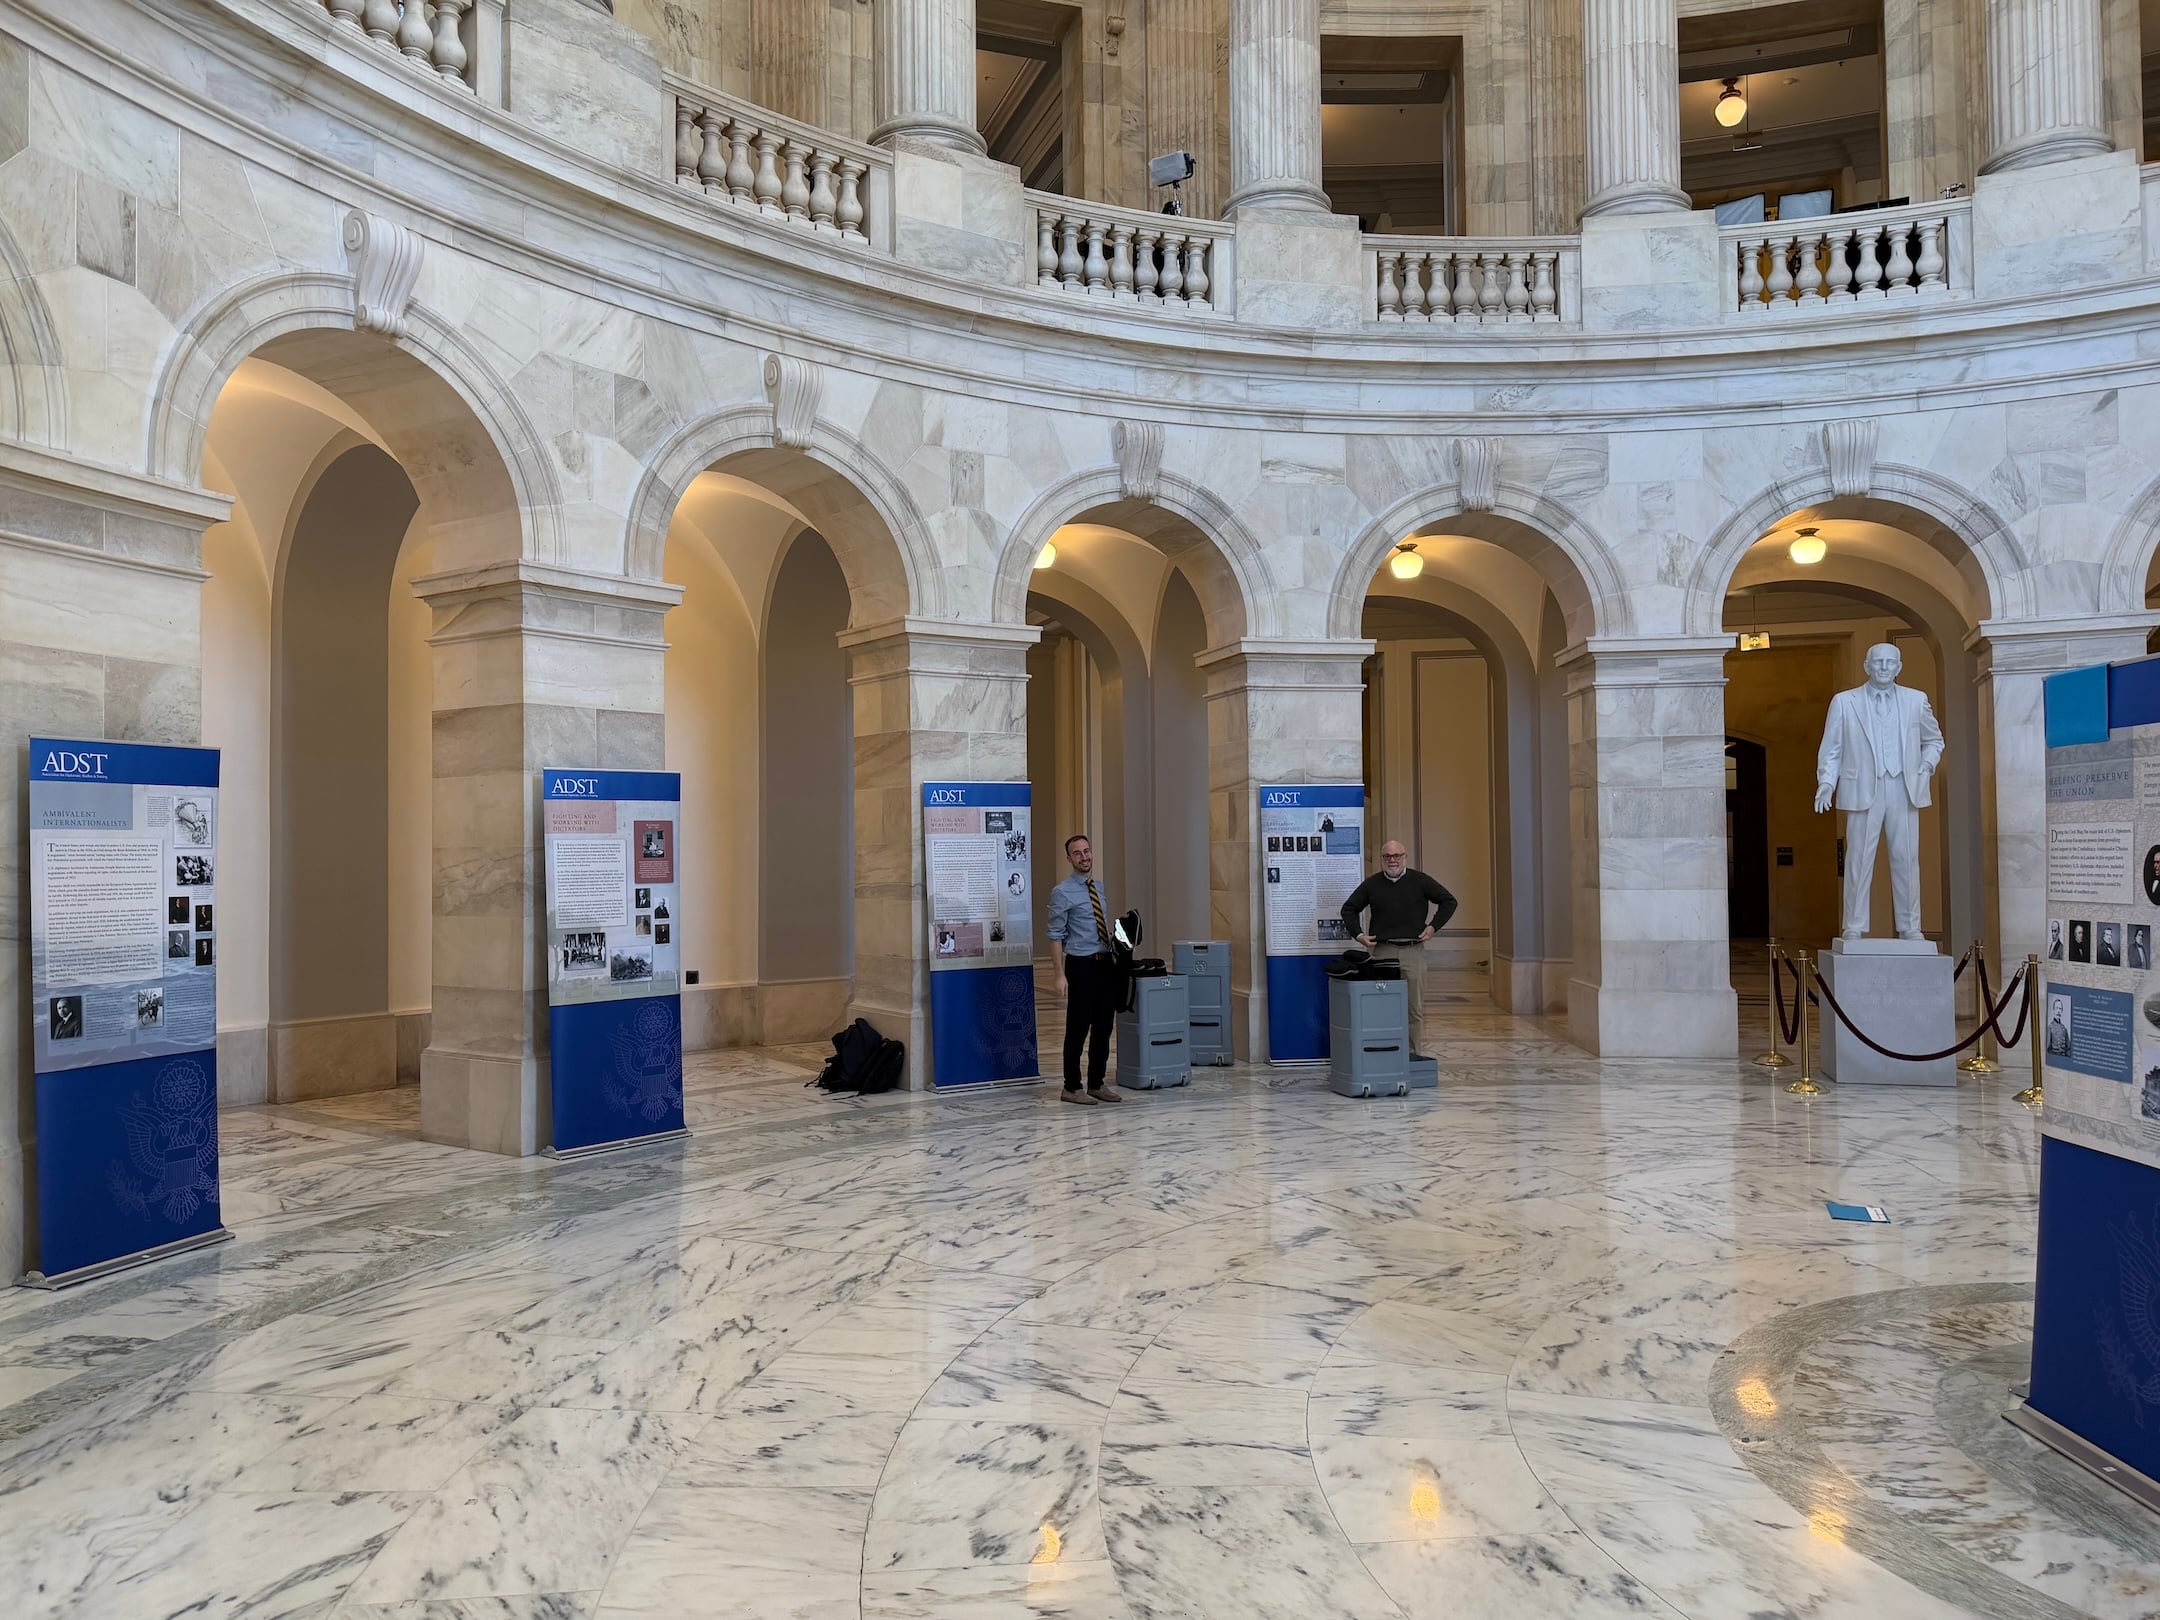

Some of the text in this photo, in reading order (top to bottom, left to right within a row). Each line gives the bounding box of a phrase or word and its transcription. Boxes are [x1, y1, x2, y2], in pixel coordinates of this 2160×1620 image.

[41, 751, 108, 774] ADST
[2085, 771, 2129, 784] PRESERVE
[551, 778, 598, 794] ADST
[2065, 786, 2095, 797] UNION
[930, 789, 966, 802] ADST
[1266, 791, 1300, 804] ADST
[43, 819, 127, 827] INTERNATIONALISTS
